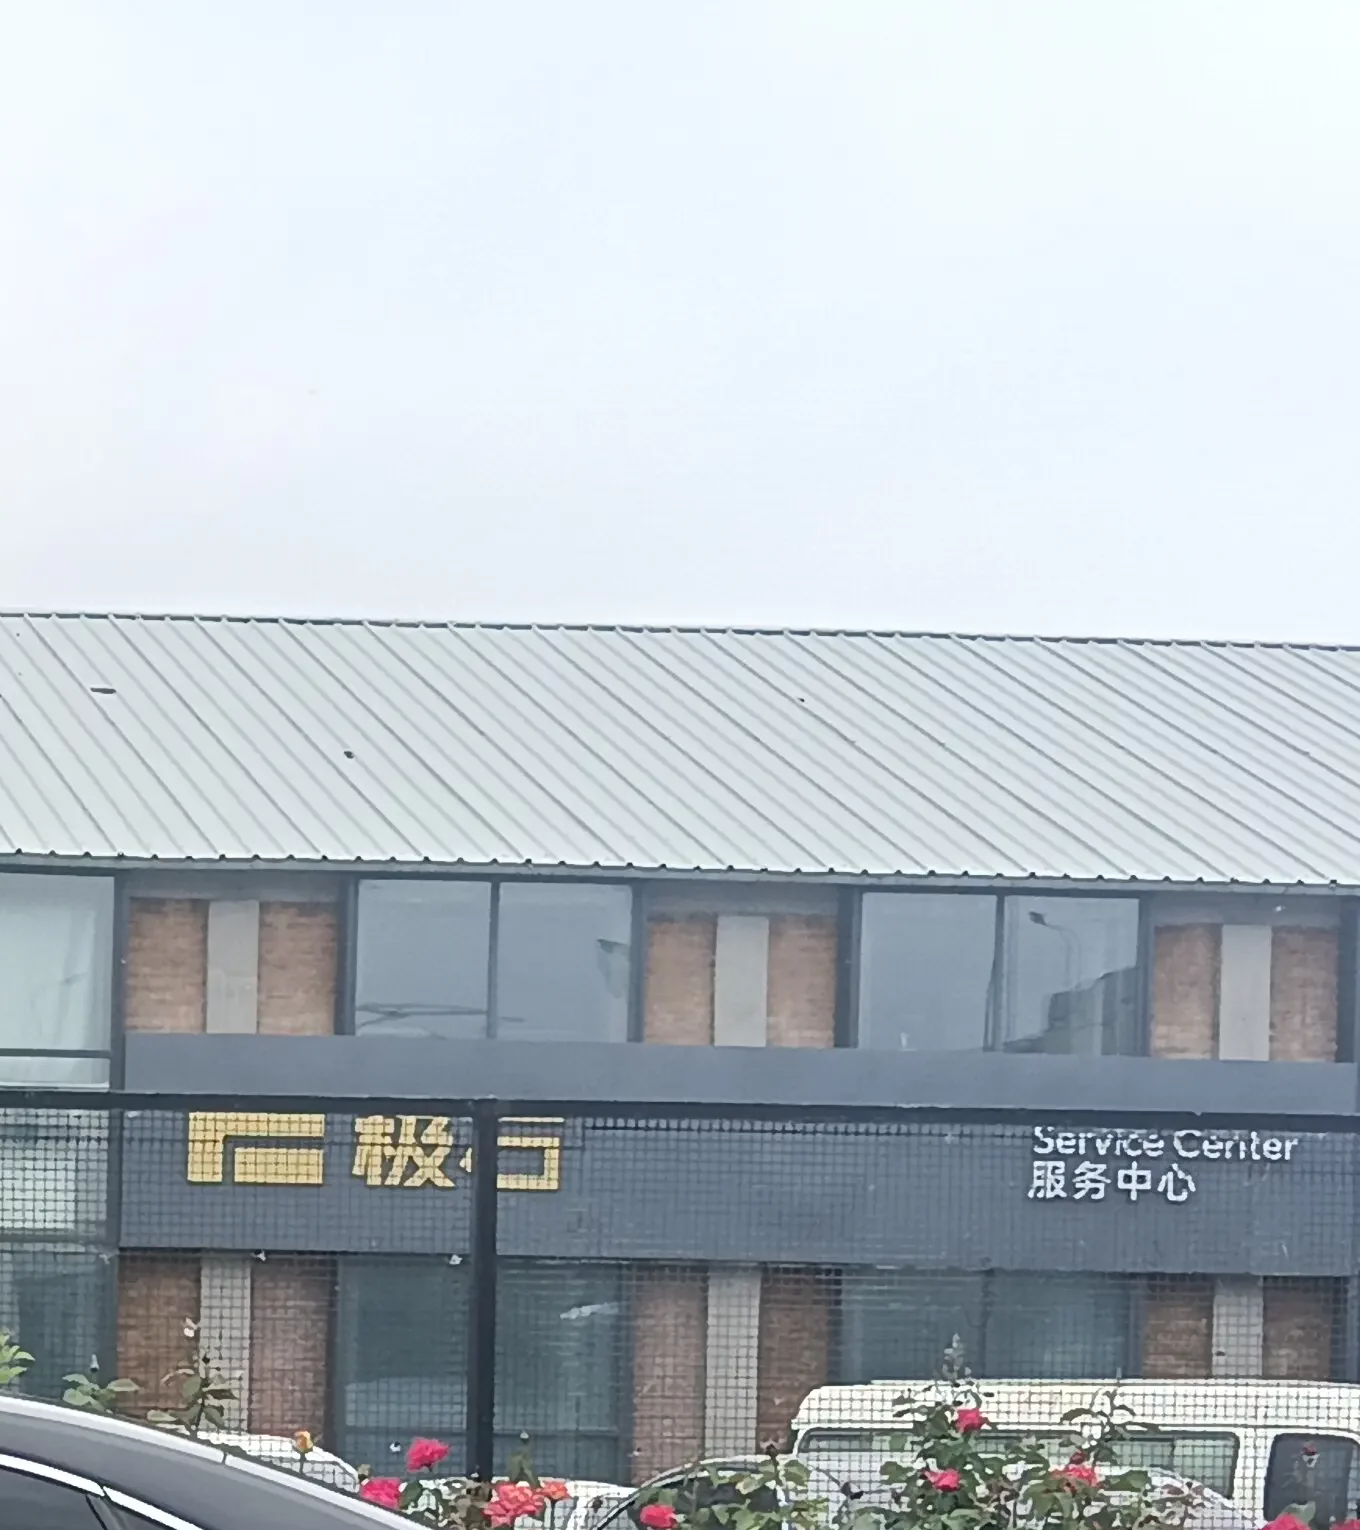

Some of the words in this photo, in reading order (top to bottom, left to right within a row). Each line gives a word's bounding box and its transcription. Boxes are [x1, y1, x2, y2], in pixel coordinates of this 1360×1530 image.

[1033, 1126, 1164, 1157] Service
[1173, 1129, 1299, 1161] Center
[1028, 1160, 1196, 1202] 服务中心
